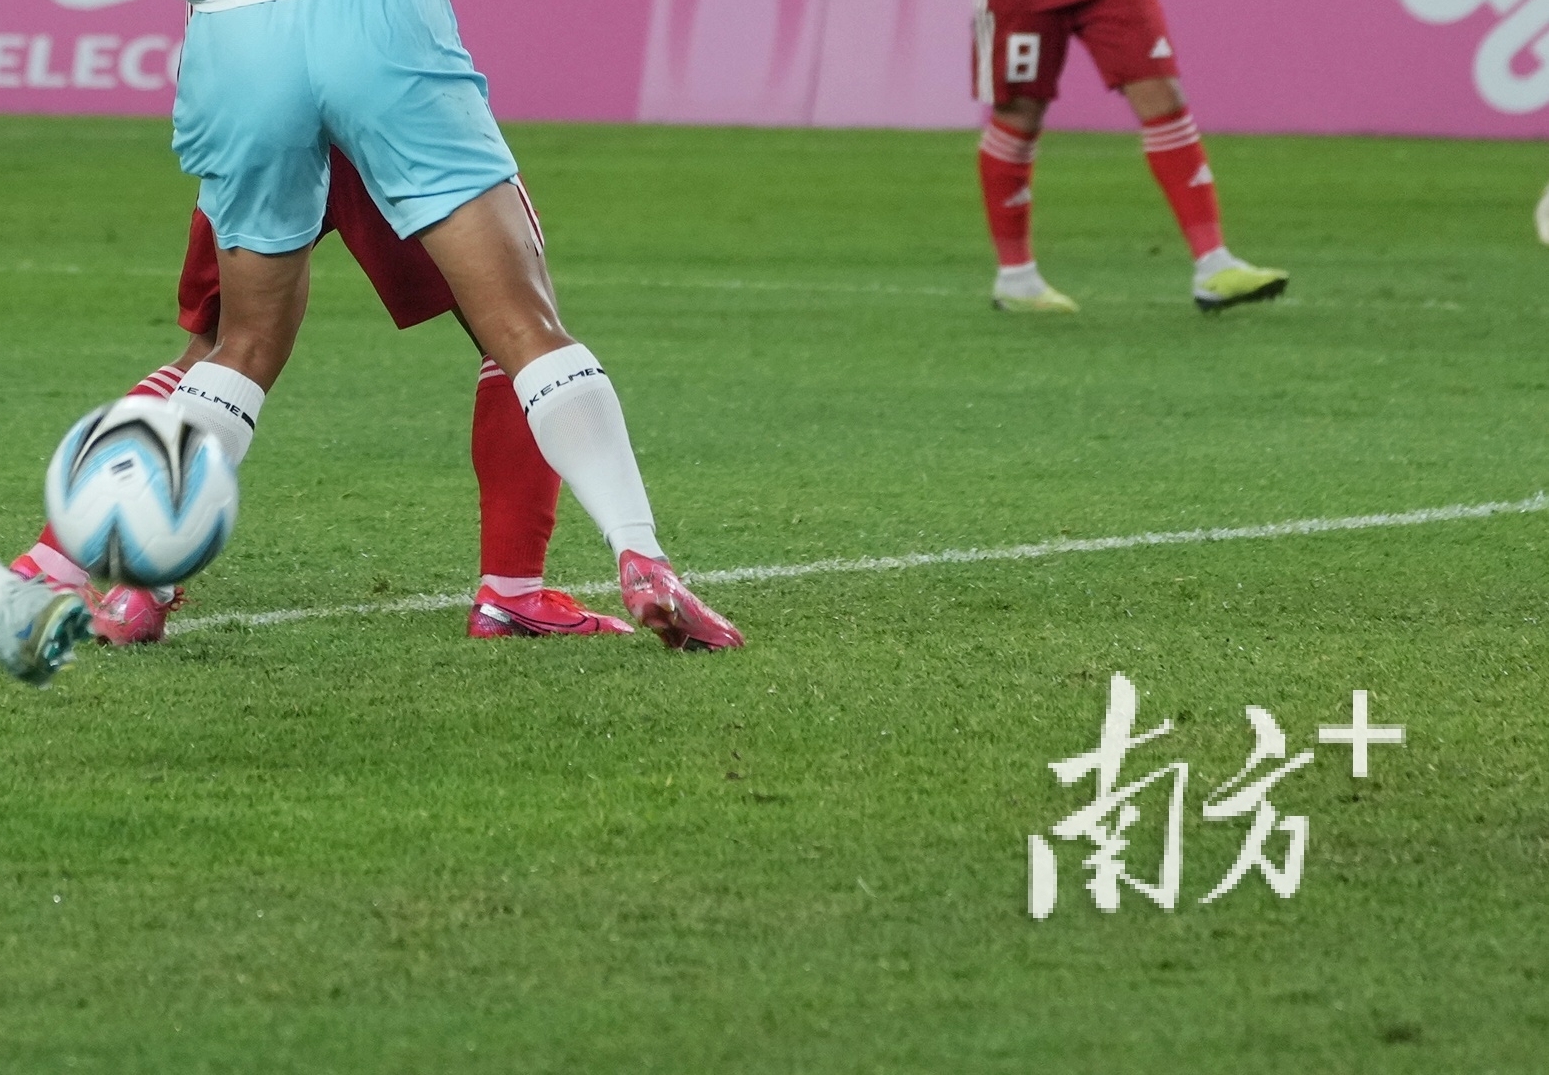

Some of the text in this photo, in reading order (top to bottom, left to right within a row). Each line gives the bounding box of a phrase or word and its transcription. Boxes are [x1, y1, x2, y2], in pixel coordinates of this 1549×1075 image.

[1006, 33, 1041, 82] 8
[177, 385, 242, 417] KELME
[529, 368, 596, 406] KELME
